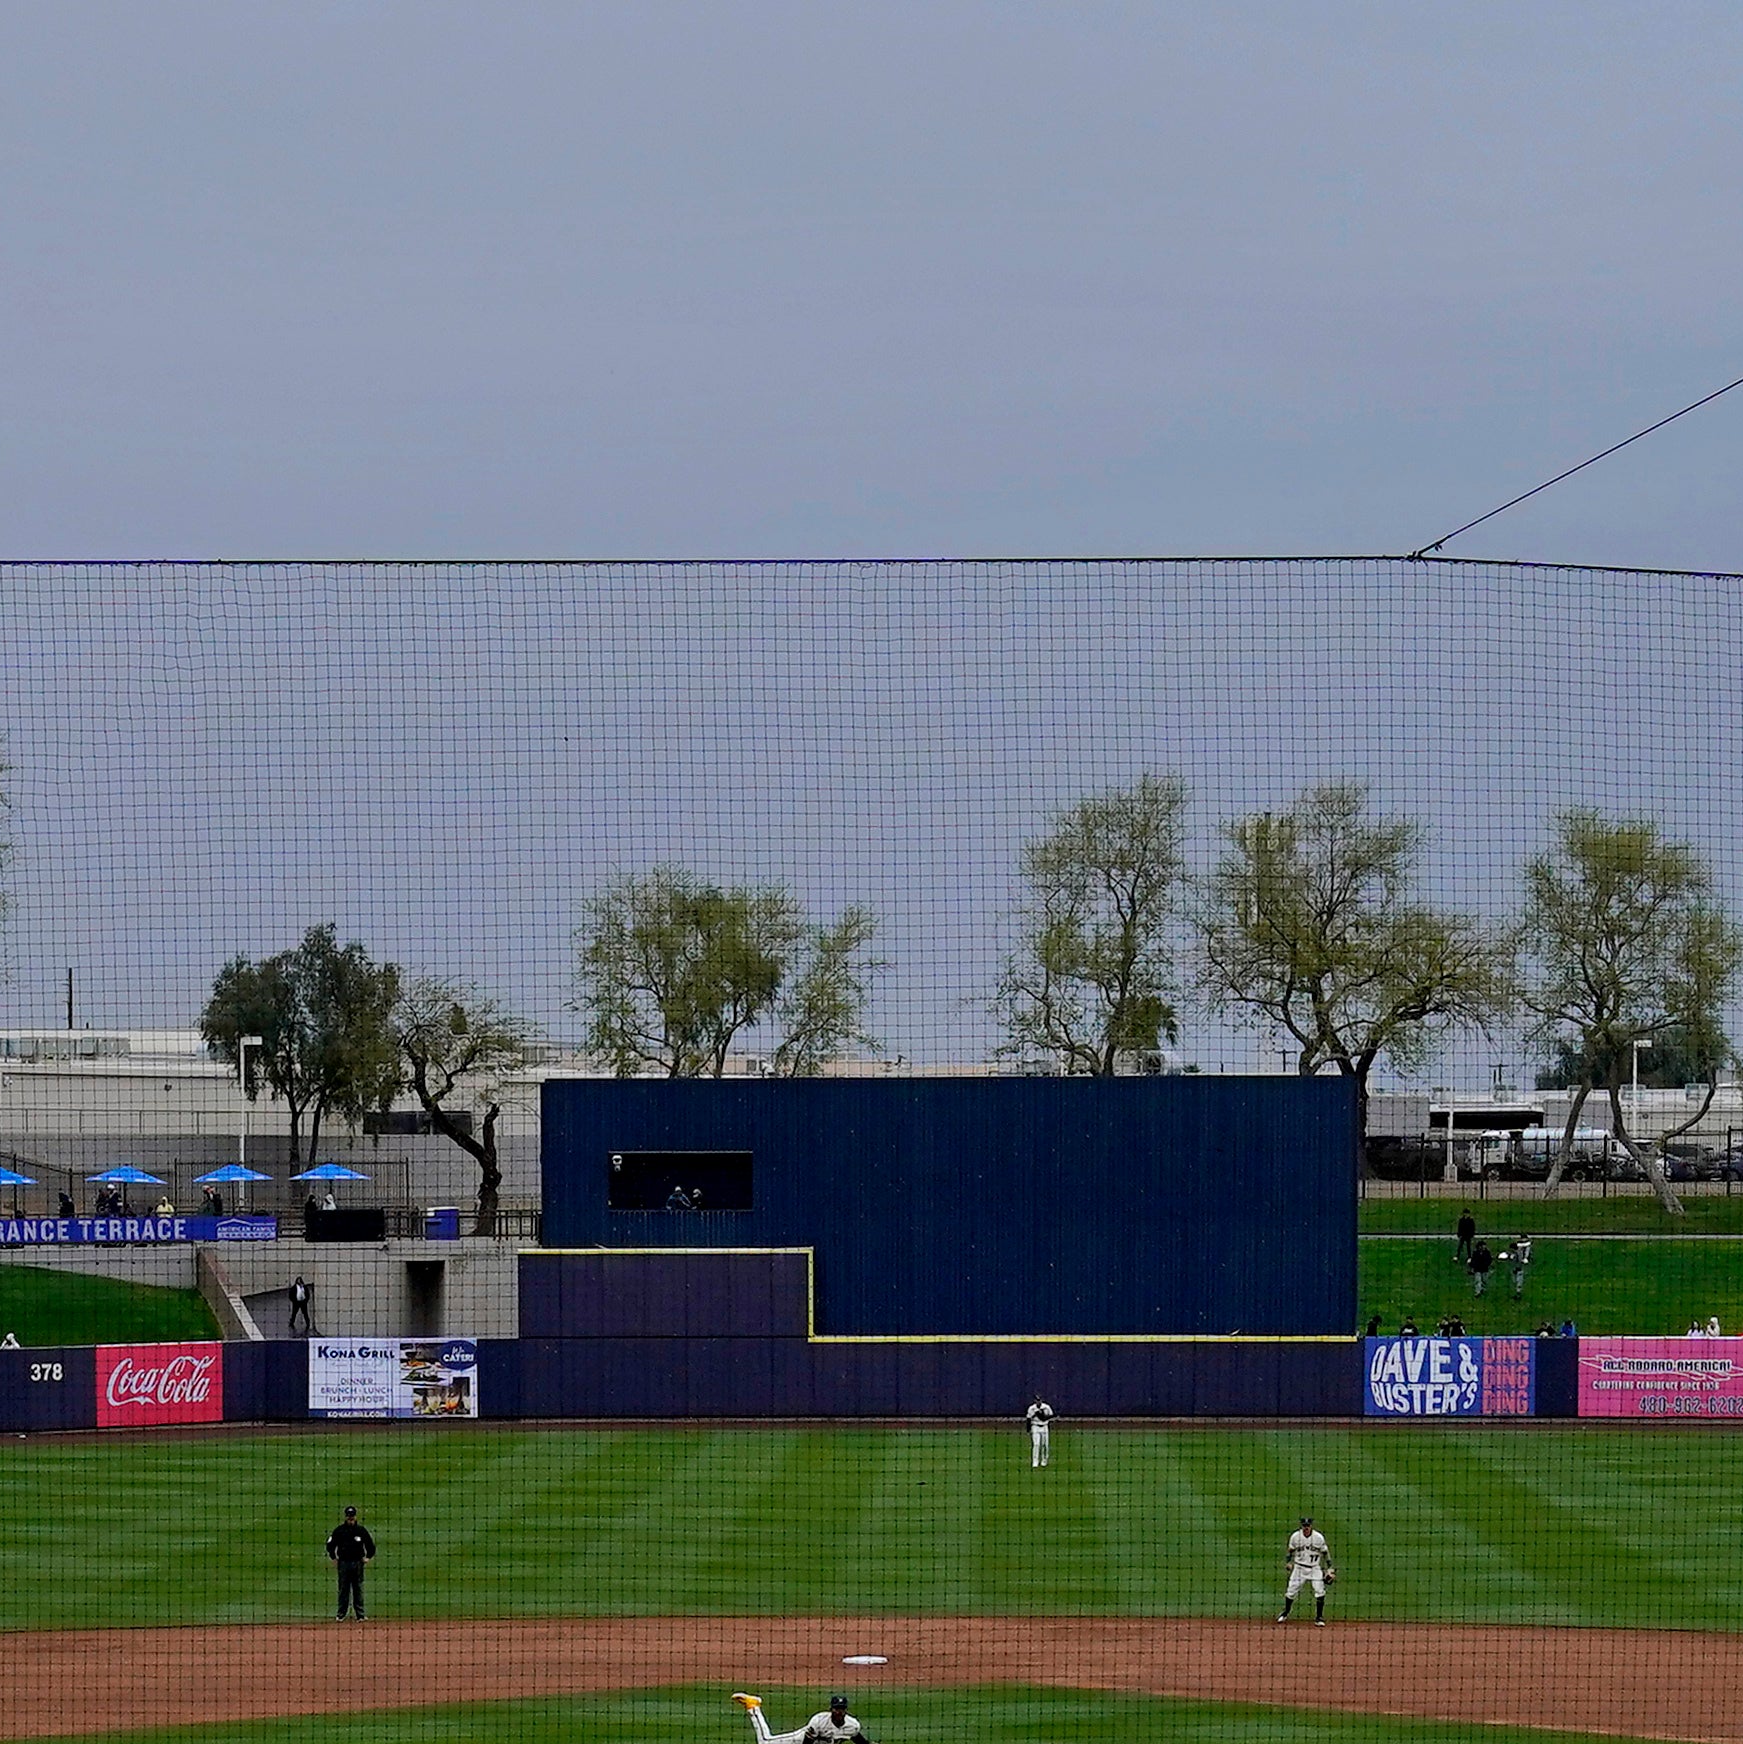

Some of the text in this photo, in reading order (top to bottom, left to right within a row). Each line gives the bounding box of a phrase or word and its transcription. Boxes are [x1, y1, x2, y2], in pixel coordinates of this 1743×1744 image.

[78, 1218, 187, 1241] TERRACE
[317, 1345, 395, 1359] KONA GRILL
[1370, 1340, 1478, 1383] DAVE &
[1483, 1339, 1529, 1363] DING
[30, 1363, 63, 1382] 378
[106, 1355, 216, 1407] Coca-Cola
[1483, 1364, 1529, 1389] DING
[1371, 1382, 1478, 1415] BUSTER'S
[1483, 1390, 1529, 1414] DING
